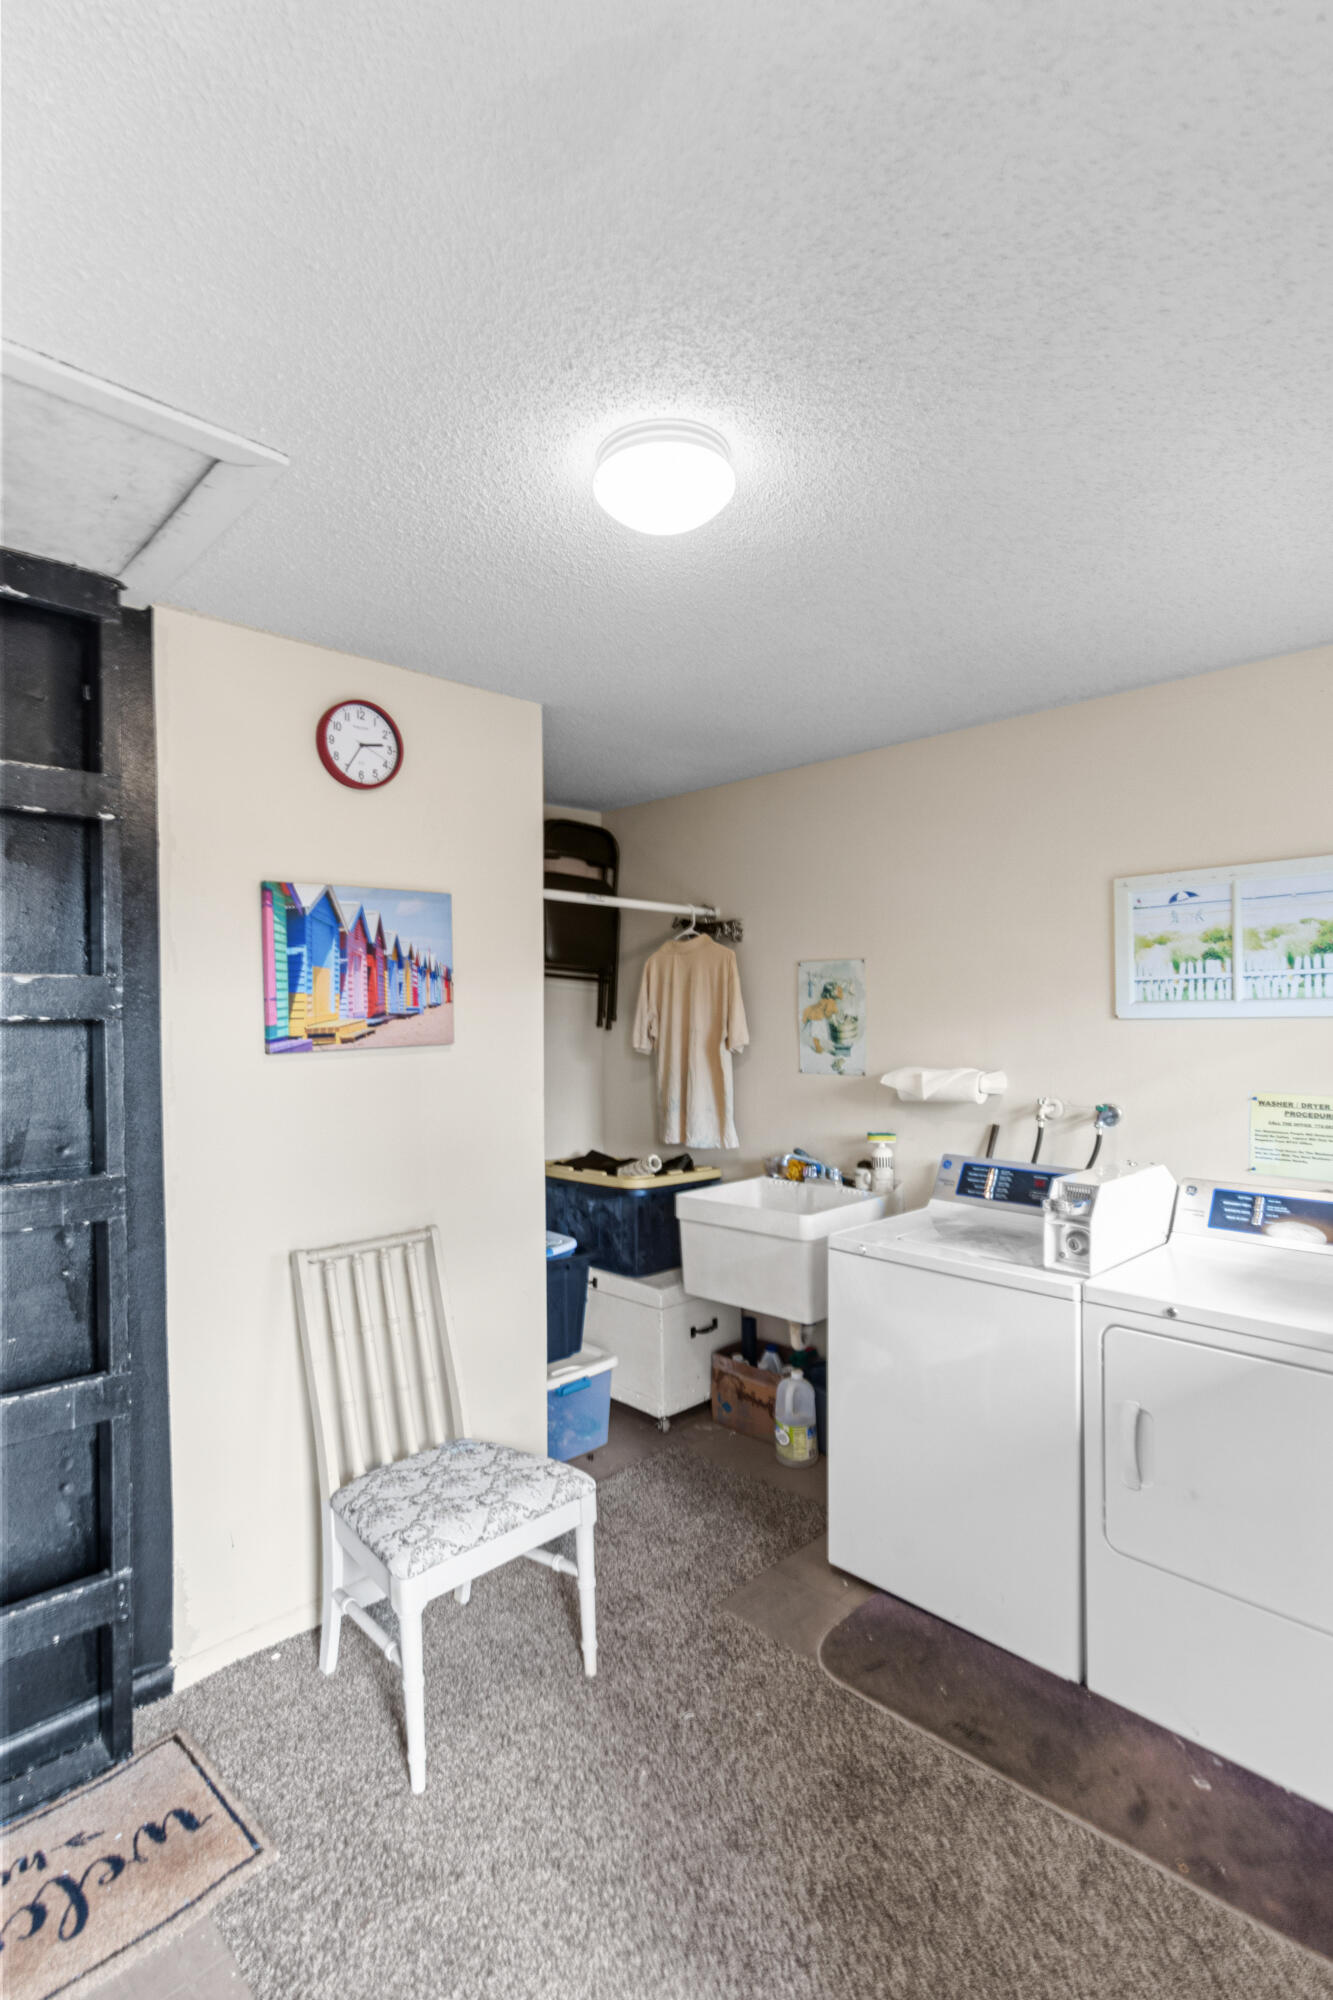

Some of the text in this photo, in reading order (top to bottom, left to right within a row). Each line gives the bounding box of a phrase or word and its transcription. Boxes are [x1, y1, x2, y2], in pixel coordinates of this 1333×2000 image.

[344, 712, 350, 721] 11
[357, 710, 365, 720] 12
[333, 721, 342, 731] 10
[328, 734, 335, 744] 9
[382, 730, 388, 740] 2
[387, 745, 393, 755] 3
[333, 751, 340, 761] 8
[382, 760, 388, 769] 4
[358, 770, 364, 780] 6
[372, 769, 378, 778] 5
[1258, 1100, 1294, 1109] WASHER
[0, 1808, 213, 1951] welc
